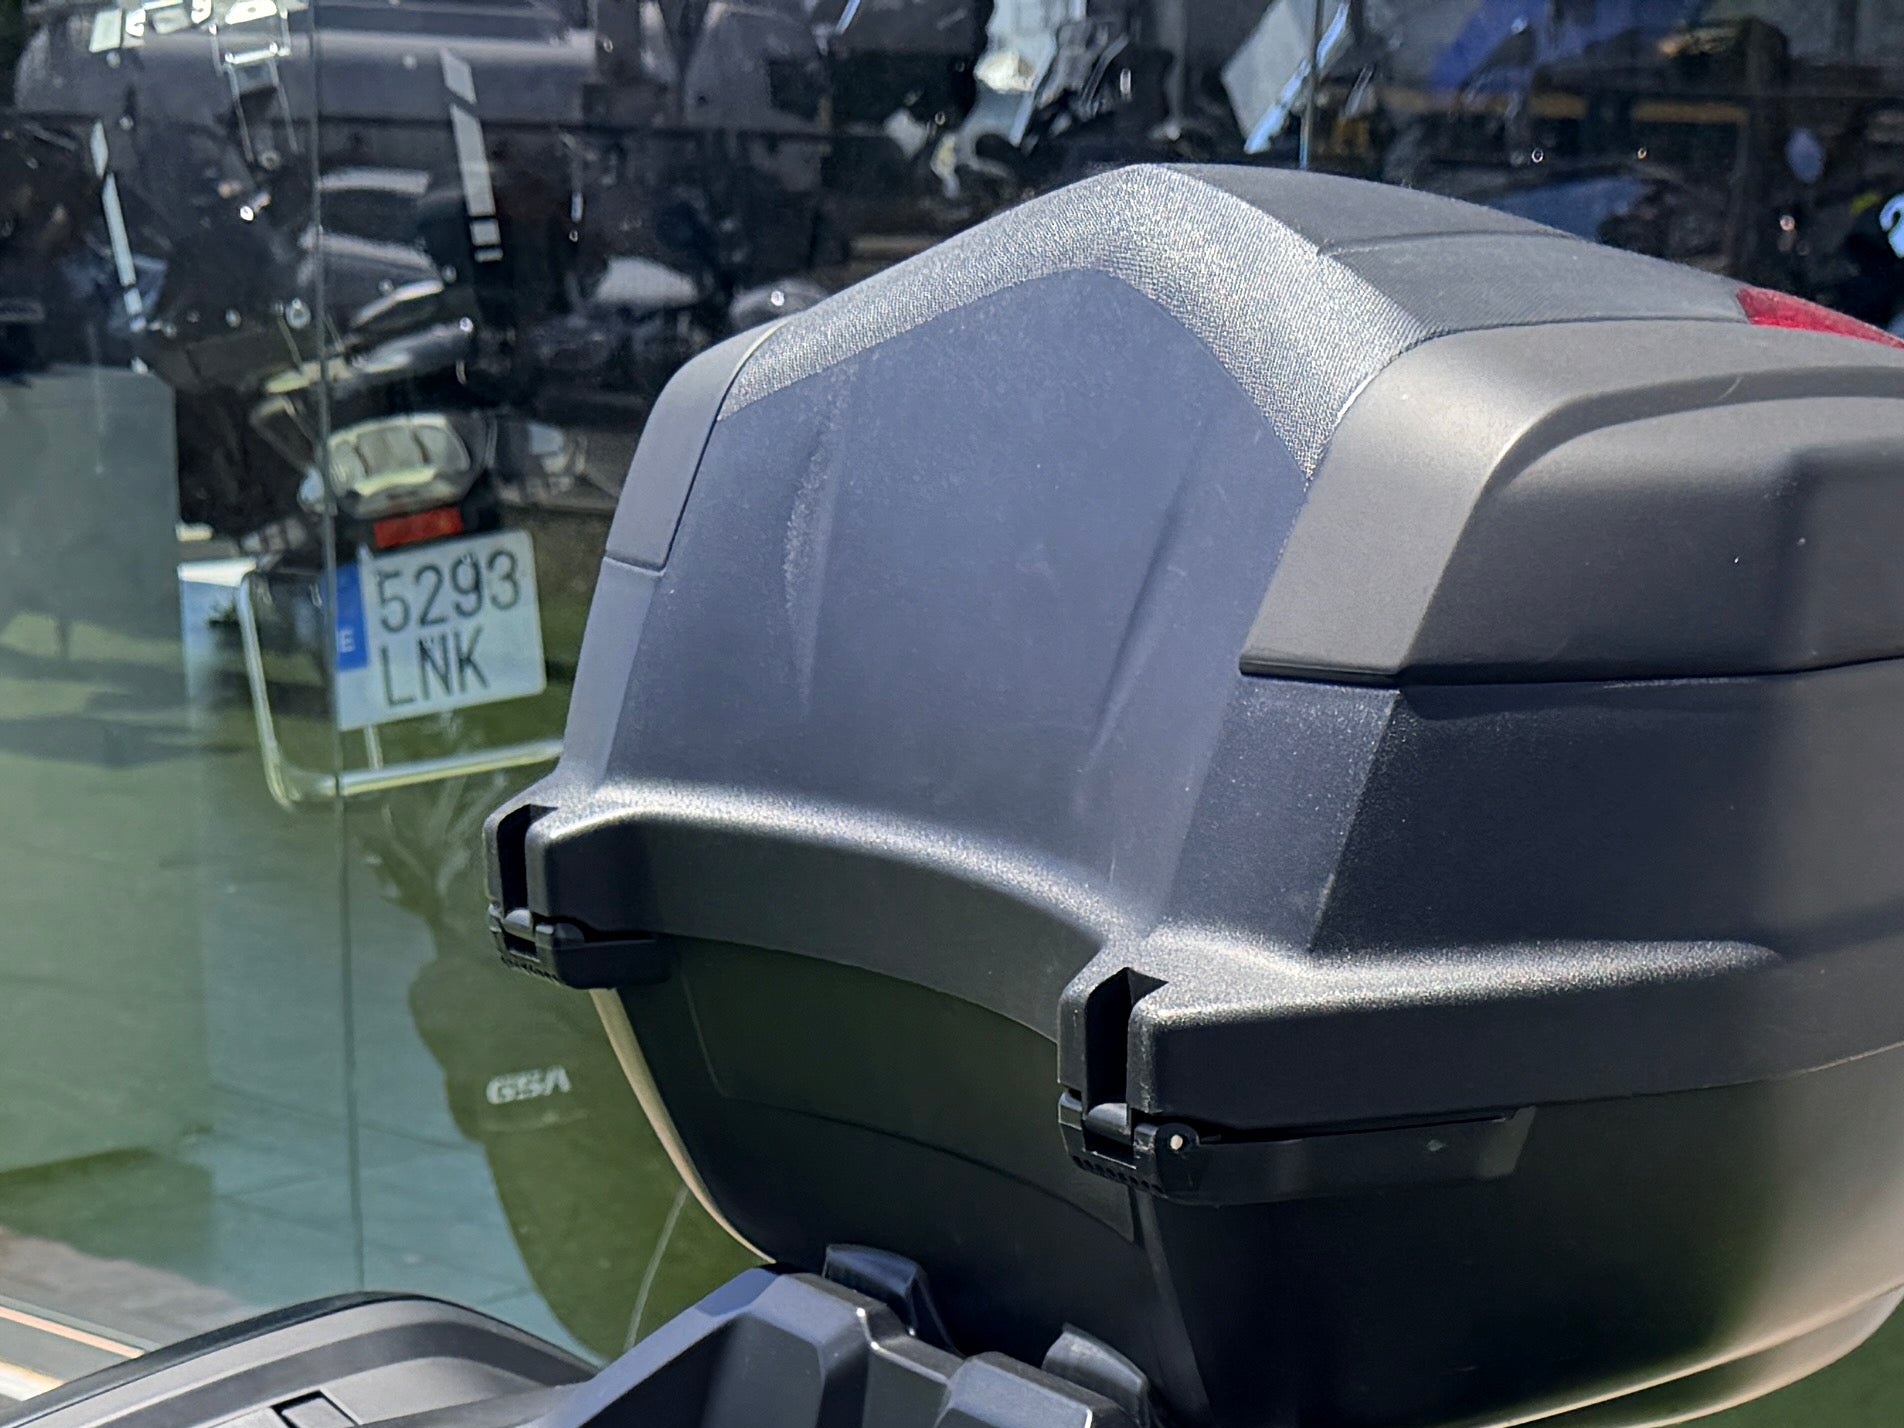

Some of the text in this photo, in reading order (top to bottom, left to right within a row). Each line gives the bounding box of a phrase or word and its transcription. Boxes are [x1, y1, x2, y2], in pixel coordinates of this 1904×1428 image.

[376, 549, 521, 633] 5293
[339, 629, 354, 653] E
[380, 624, 490, 706] LNK
[486, 1065, 572, 1104] GSA
